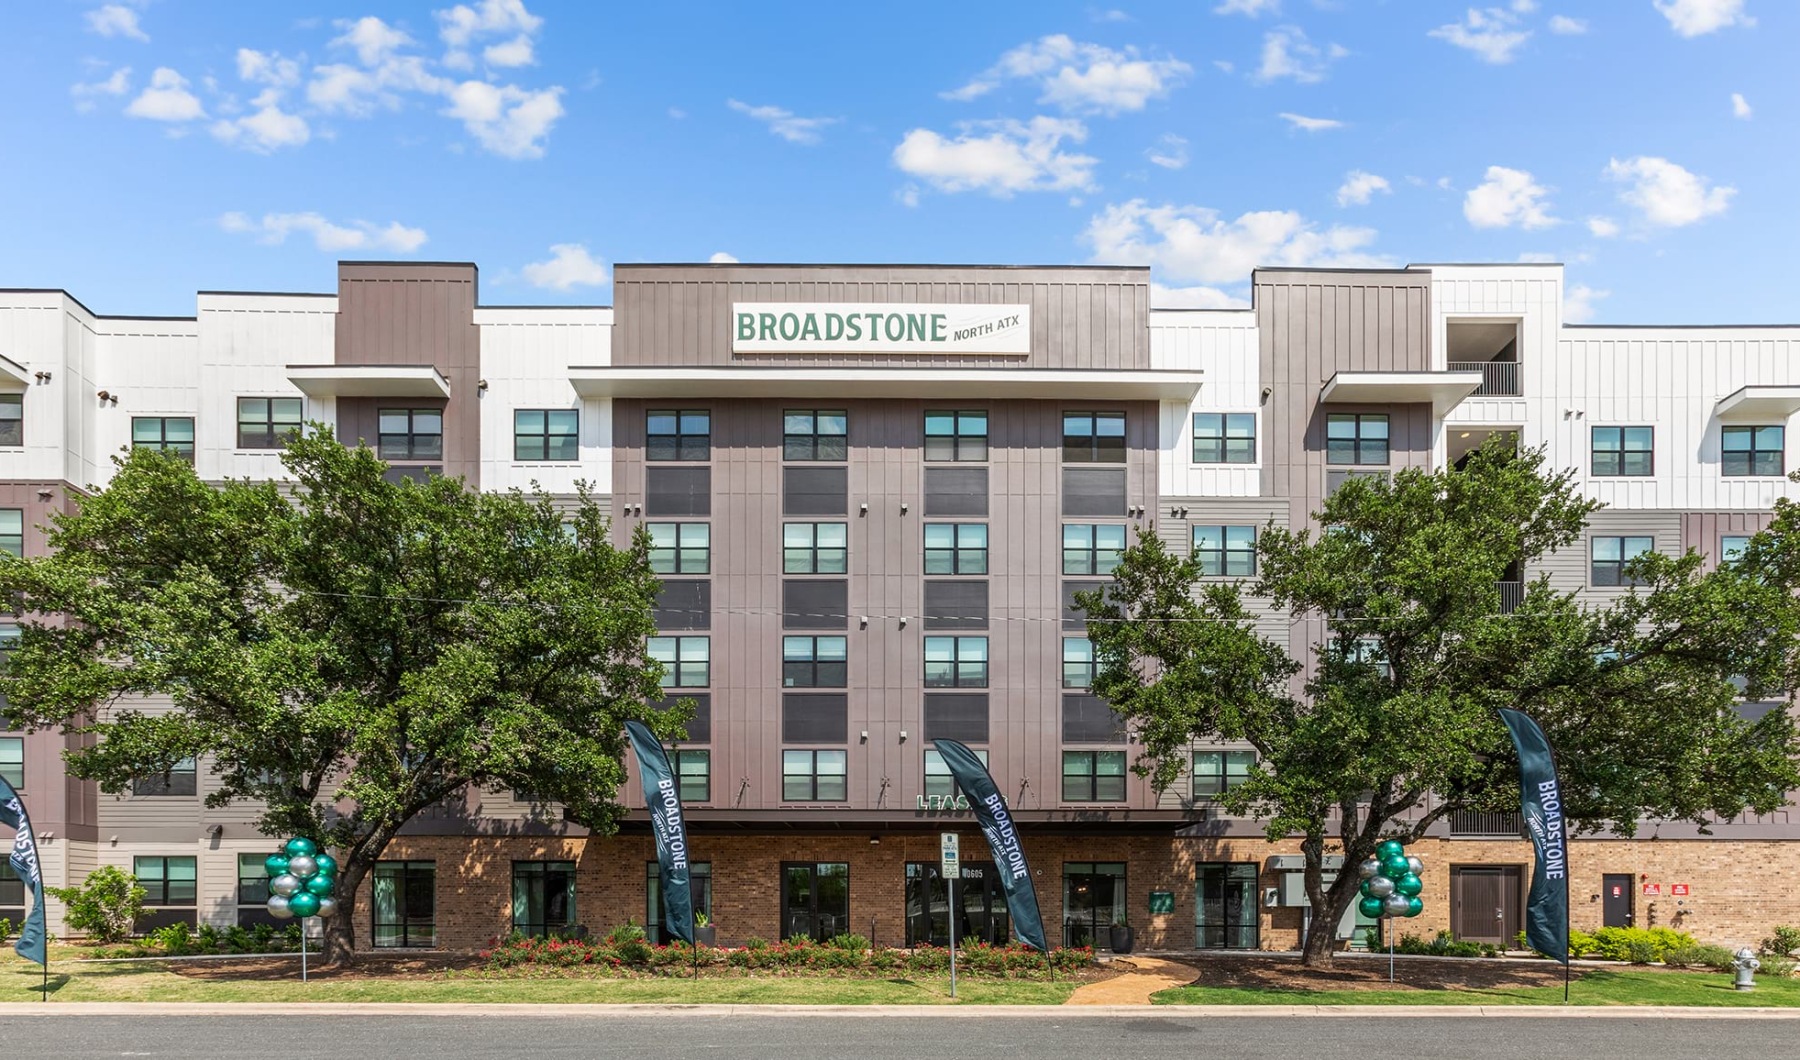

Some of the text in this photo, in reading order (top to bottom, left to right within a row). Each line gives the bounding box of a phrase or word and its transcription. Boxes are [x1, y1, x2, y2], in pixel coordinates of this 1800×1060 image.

[737, 312, 1020, 342] BROADSTONE NORTH ATX
[652, 813, 665, 833] NORTH
[658, 778, 687, 869] BROADSTONE
[984, 793, 1027, 879] BROADSTONE
[1538, 780, 1564, 880] BROADSTONE
